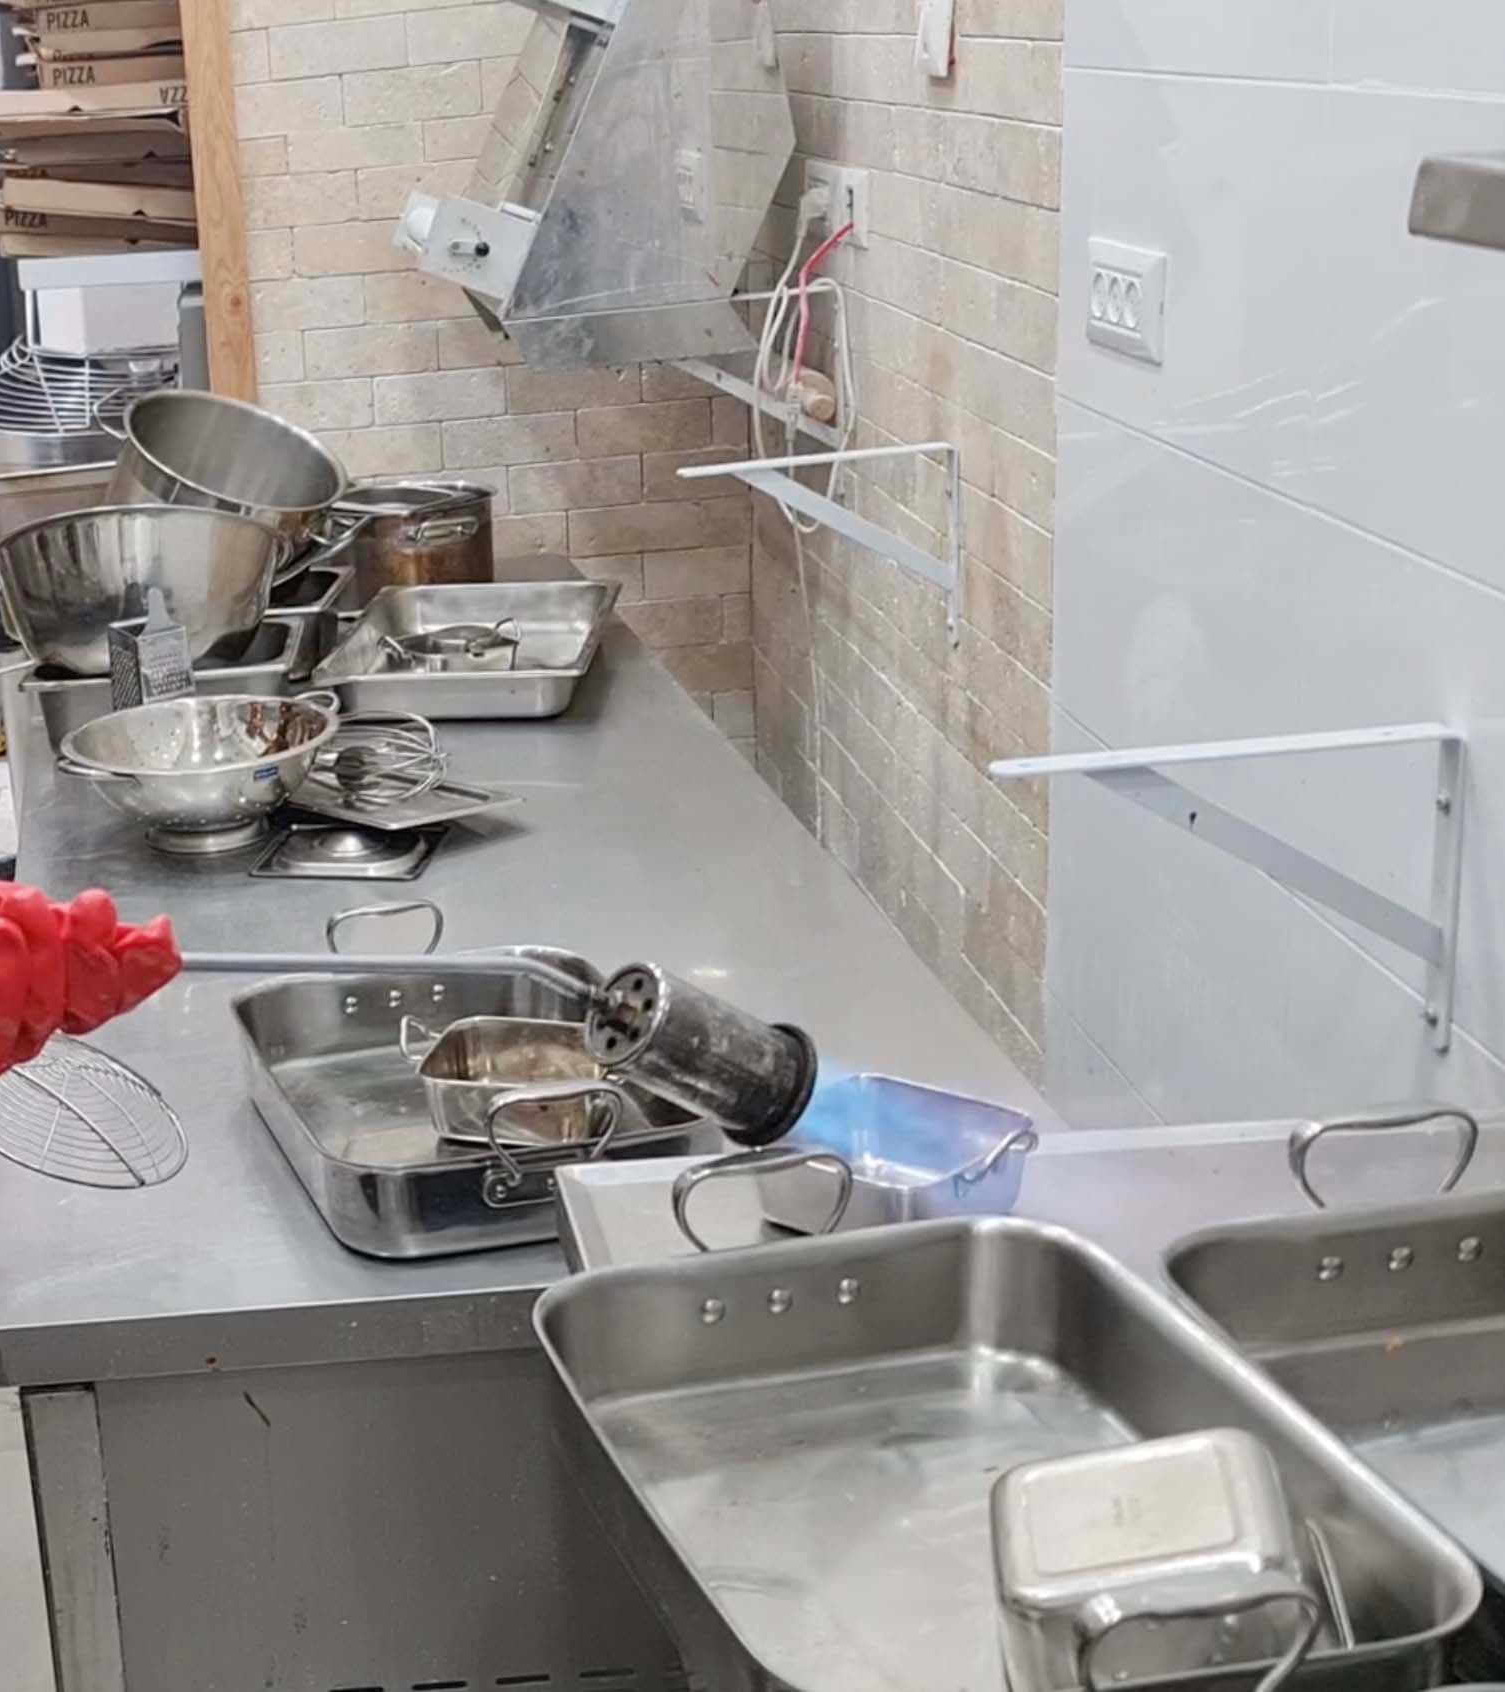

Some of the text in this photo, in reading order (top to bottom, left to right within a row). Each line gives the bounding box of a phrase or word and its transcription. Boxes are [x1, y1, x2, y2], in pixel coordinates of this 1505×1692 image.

[46, 9, 90, 31] PIZZA
[52, 65, 96, 87] PIZZA
[159, 86, 188, 105] ZZA
[3, 206, 48, 229] PIZZA
